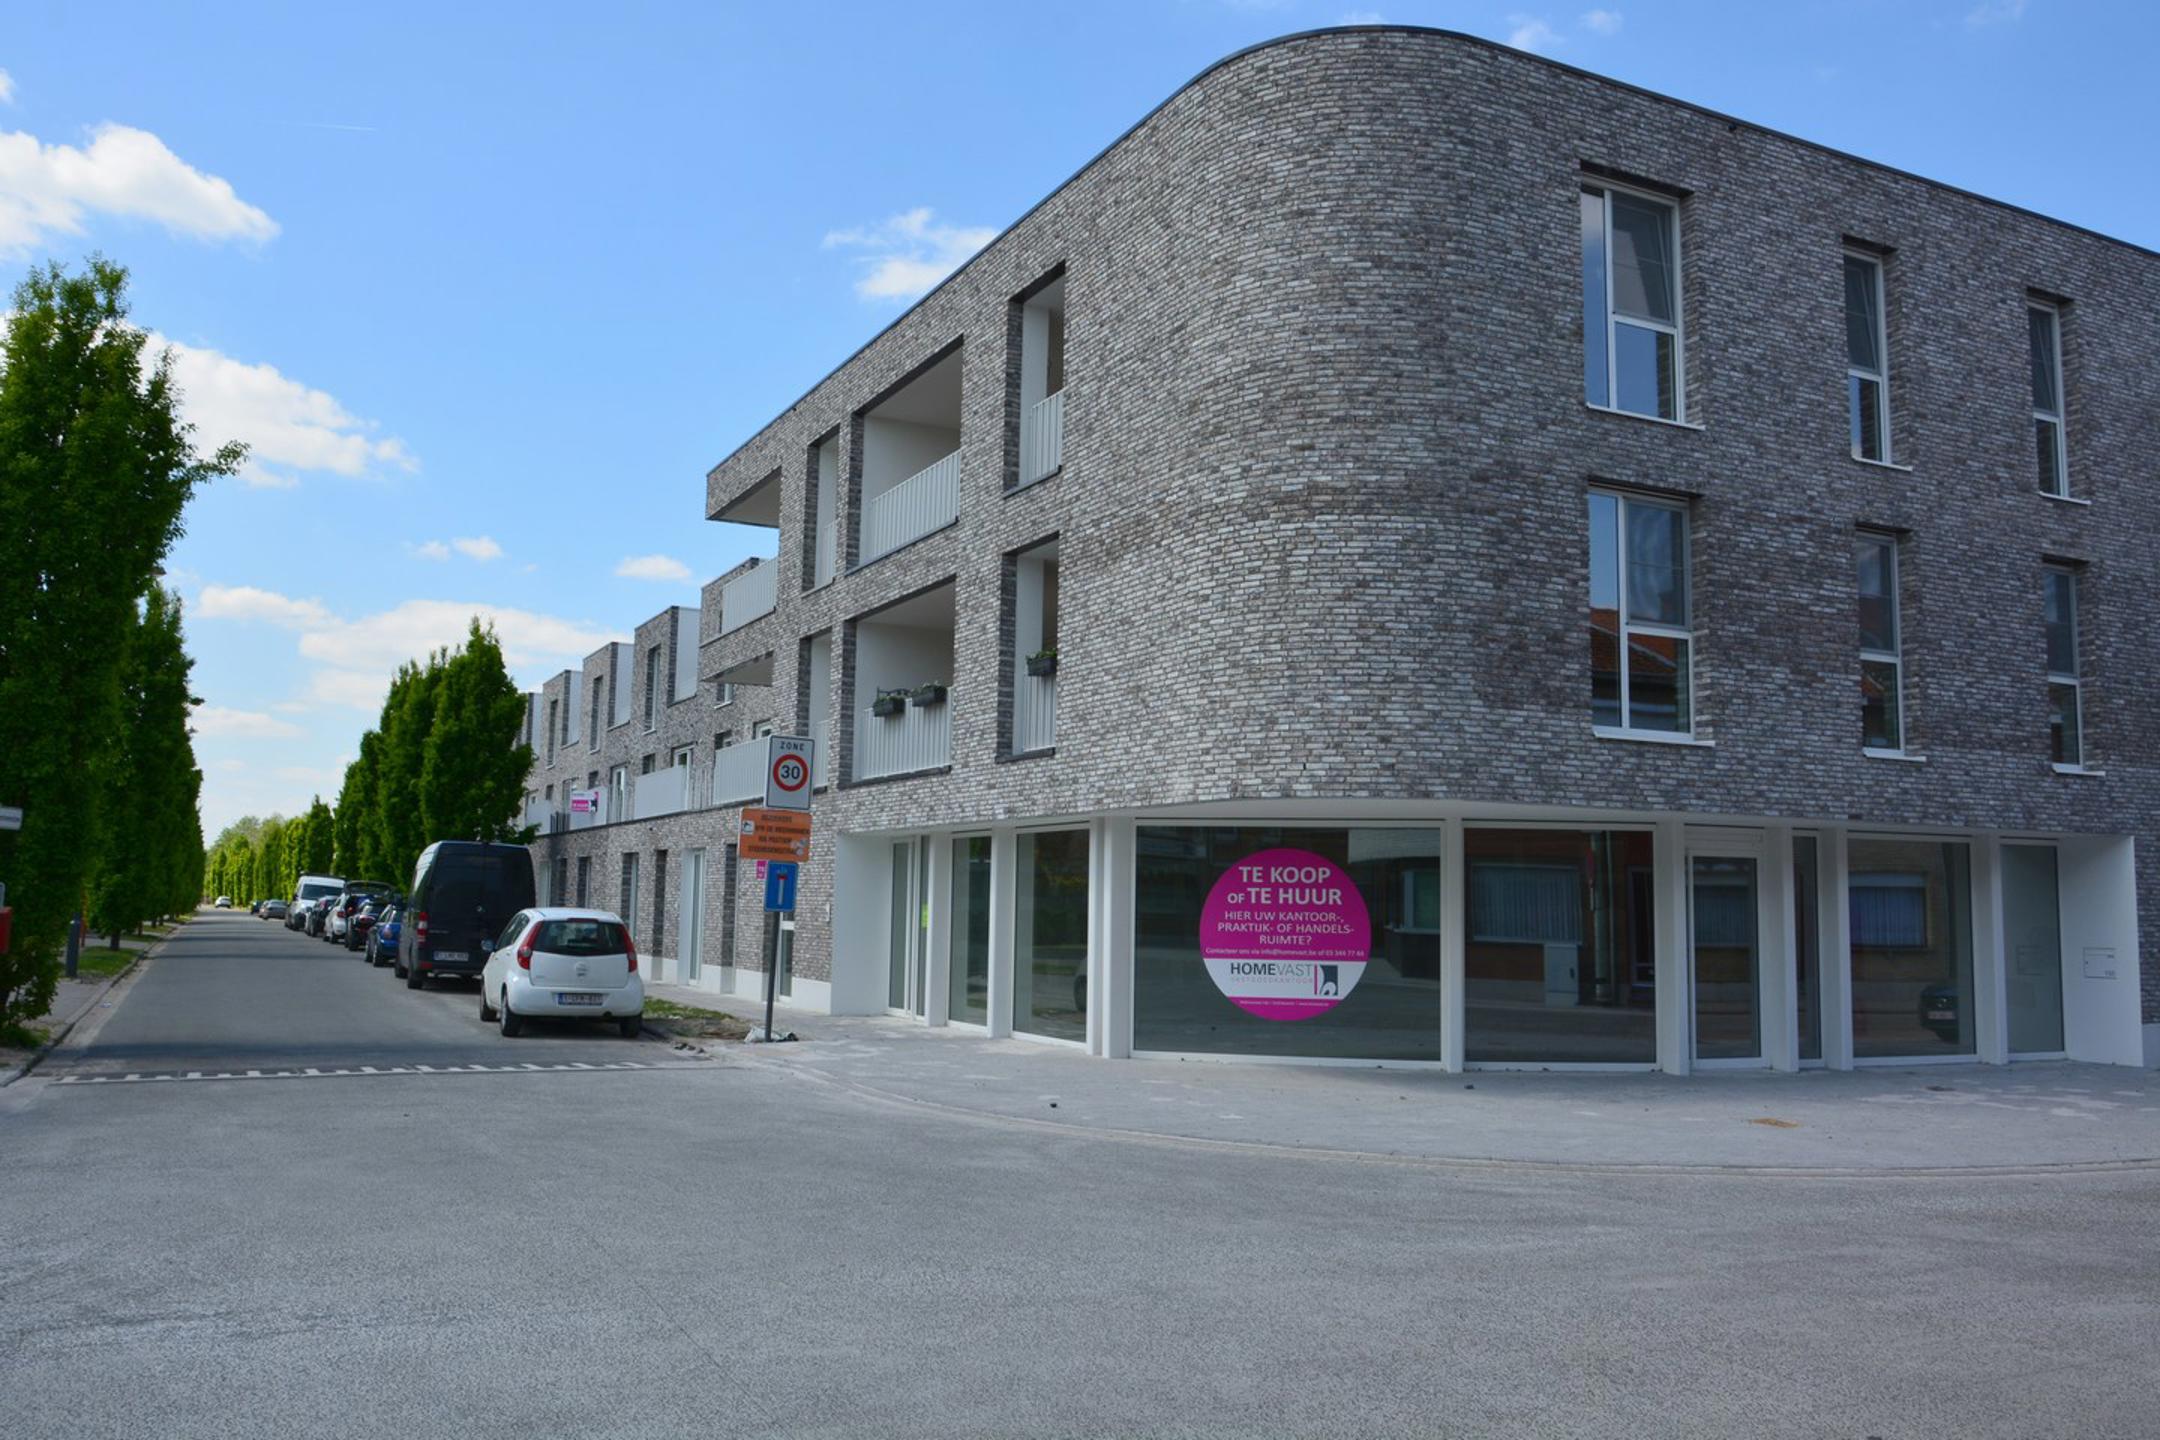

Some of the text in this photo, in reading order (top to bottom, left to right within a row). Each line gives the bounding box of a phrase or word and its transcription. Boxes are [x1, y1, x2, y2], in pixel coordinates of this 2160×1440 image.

[780, 741, 805, 751] ZONE
[781, 764, 801, 780] 30
[1238, 866, 1331, 884] TE KOOP
[1227, 887, 1342, 905] OF TE HUUR
[1224, 911, 1344, 923] HIER UW KANTOOR-,
[1217, 922, 1354, 934] PRAKTIJK- OF HANDELS-
[1259, 935, 1313, 945] RUIMTE?
[1230, 962, 1313, 977] HOMEVAST
